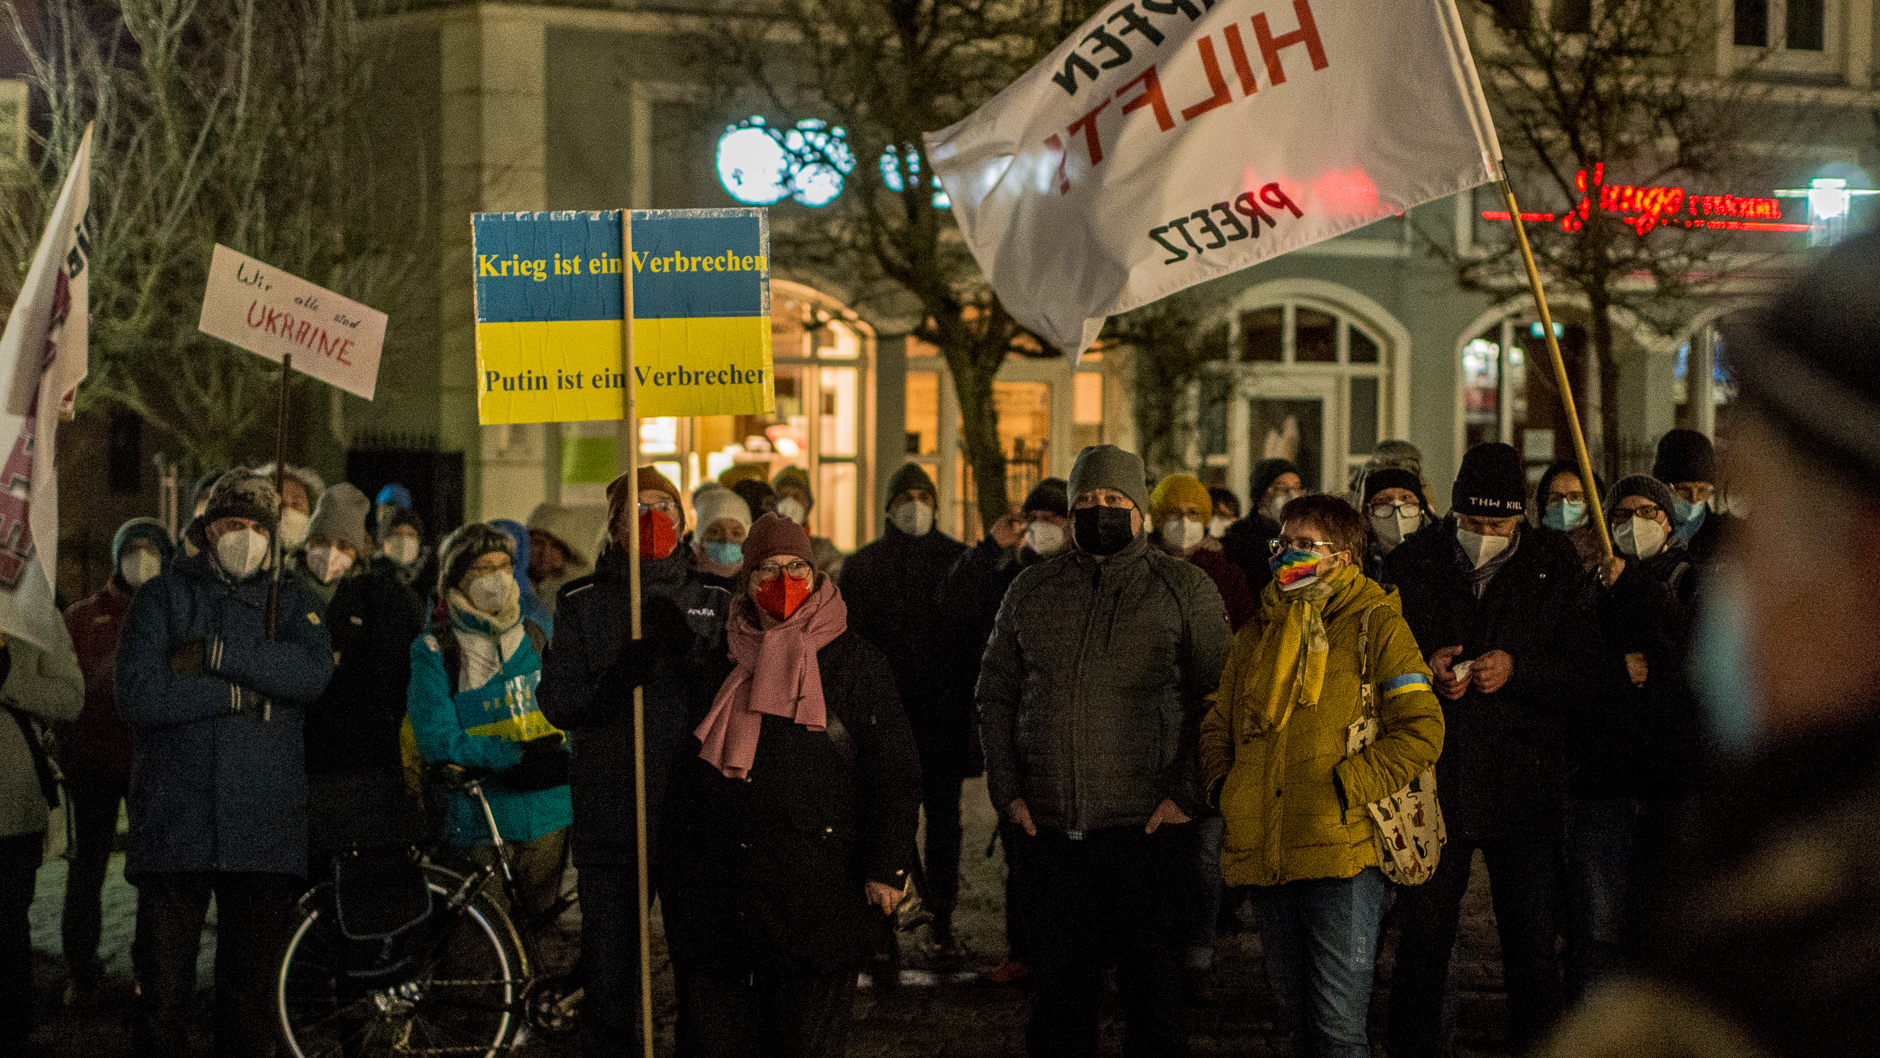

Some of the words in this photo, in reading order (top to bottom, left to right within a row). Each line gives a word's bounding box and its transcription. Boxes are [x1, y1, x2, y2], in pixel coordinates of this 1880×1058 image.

[478, 254, 547, 282] Krieg
[554, 253, 581, 275] ist
[589, 252, 624, 274] ein
[631, 250, 768, 273] Verbrechen
[236, 262, 272, 292] Wir
[294, 295, 320, 313] alle
[333, 312, 362, 329] sind
[247, 299, 355, 366] UKRAINE
[486, 369, 548, 392] Putin
[557, 369, 583, 389] ist
[592, 367, 626, 389] ein
[635, 364, 766, 387] Verbrecher
[1469, 496, 1501, 508] THW
[1505, 500, 1523, 510] KIEL
